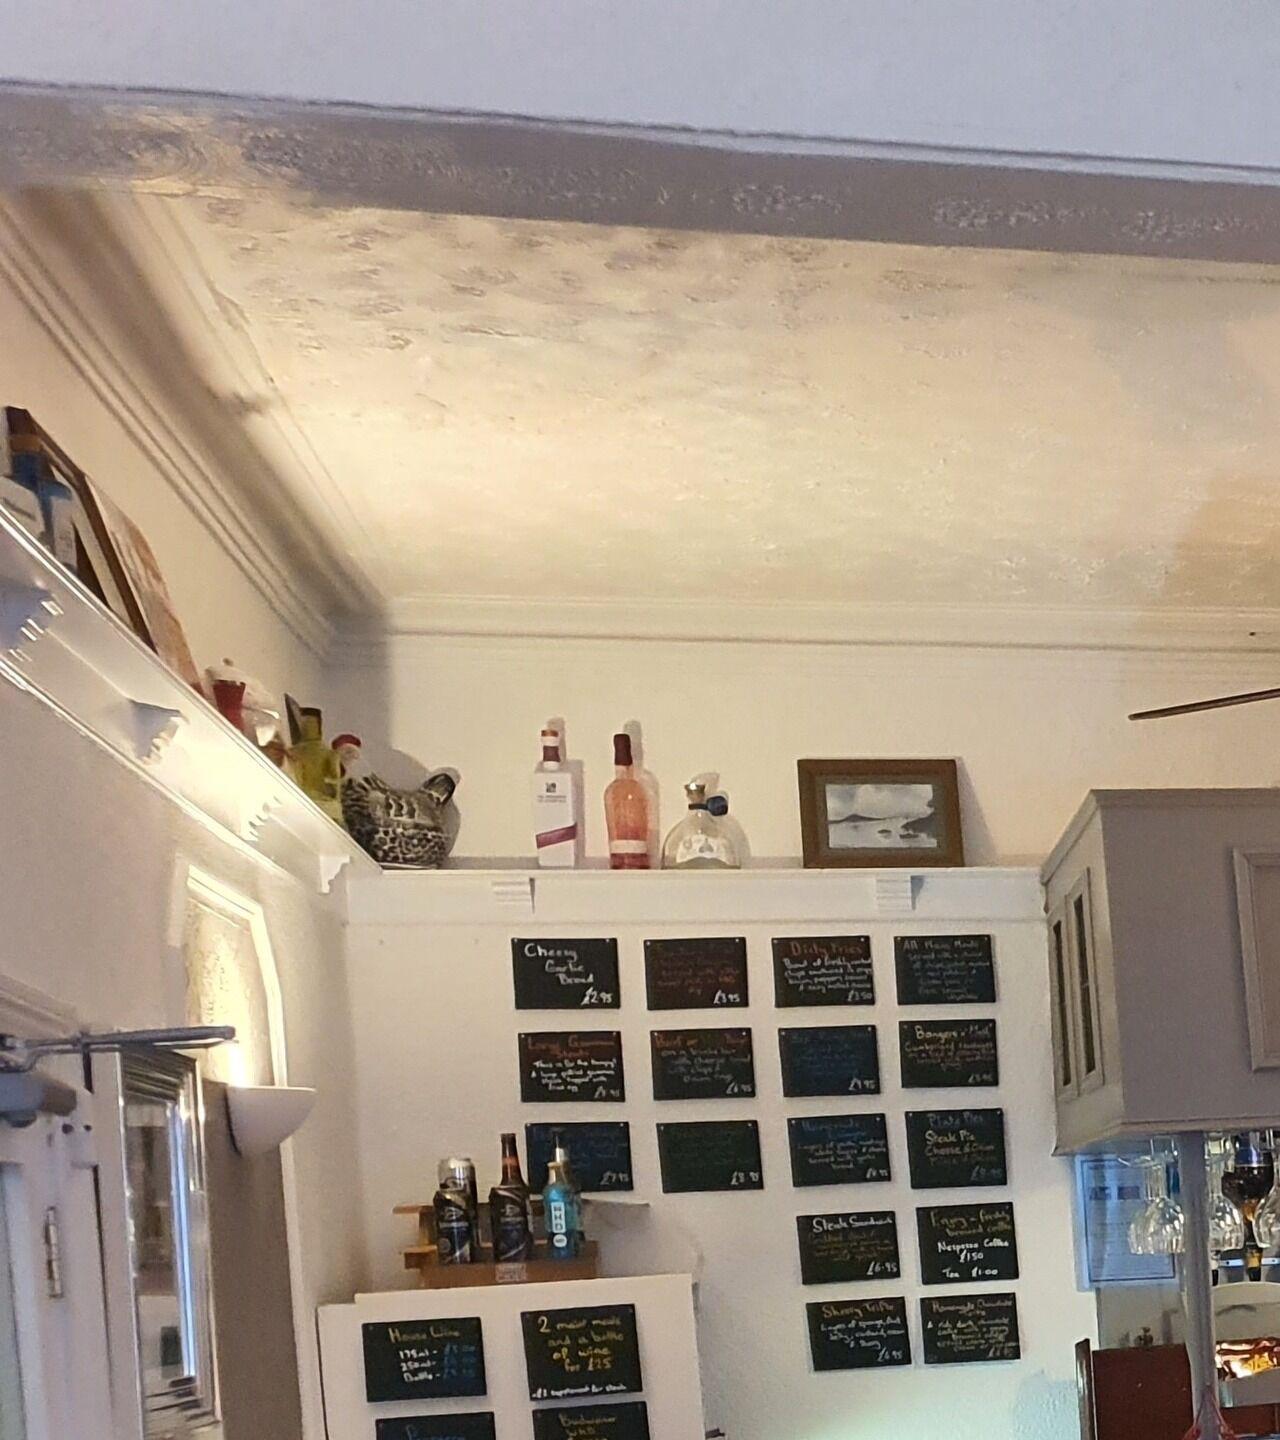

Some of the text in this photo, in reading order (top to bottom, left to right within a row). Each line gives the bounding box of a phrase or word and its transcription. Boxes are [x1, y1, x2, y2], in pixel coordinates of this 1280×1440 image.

[813, 1217, 849, 1233] Steak
[942, 1267, 960, 1278] Tea
[538, 1315, 550, 1333] 2
[578, 1346, 611, 1356] wine
